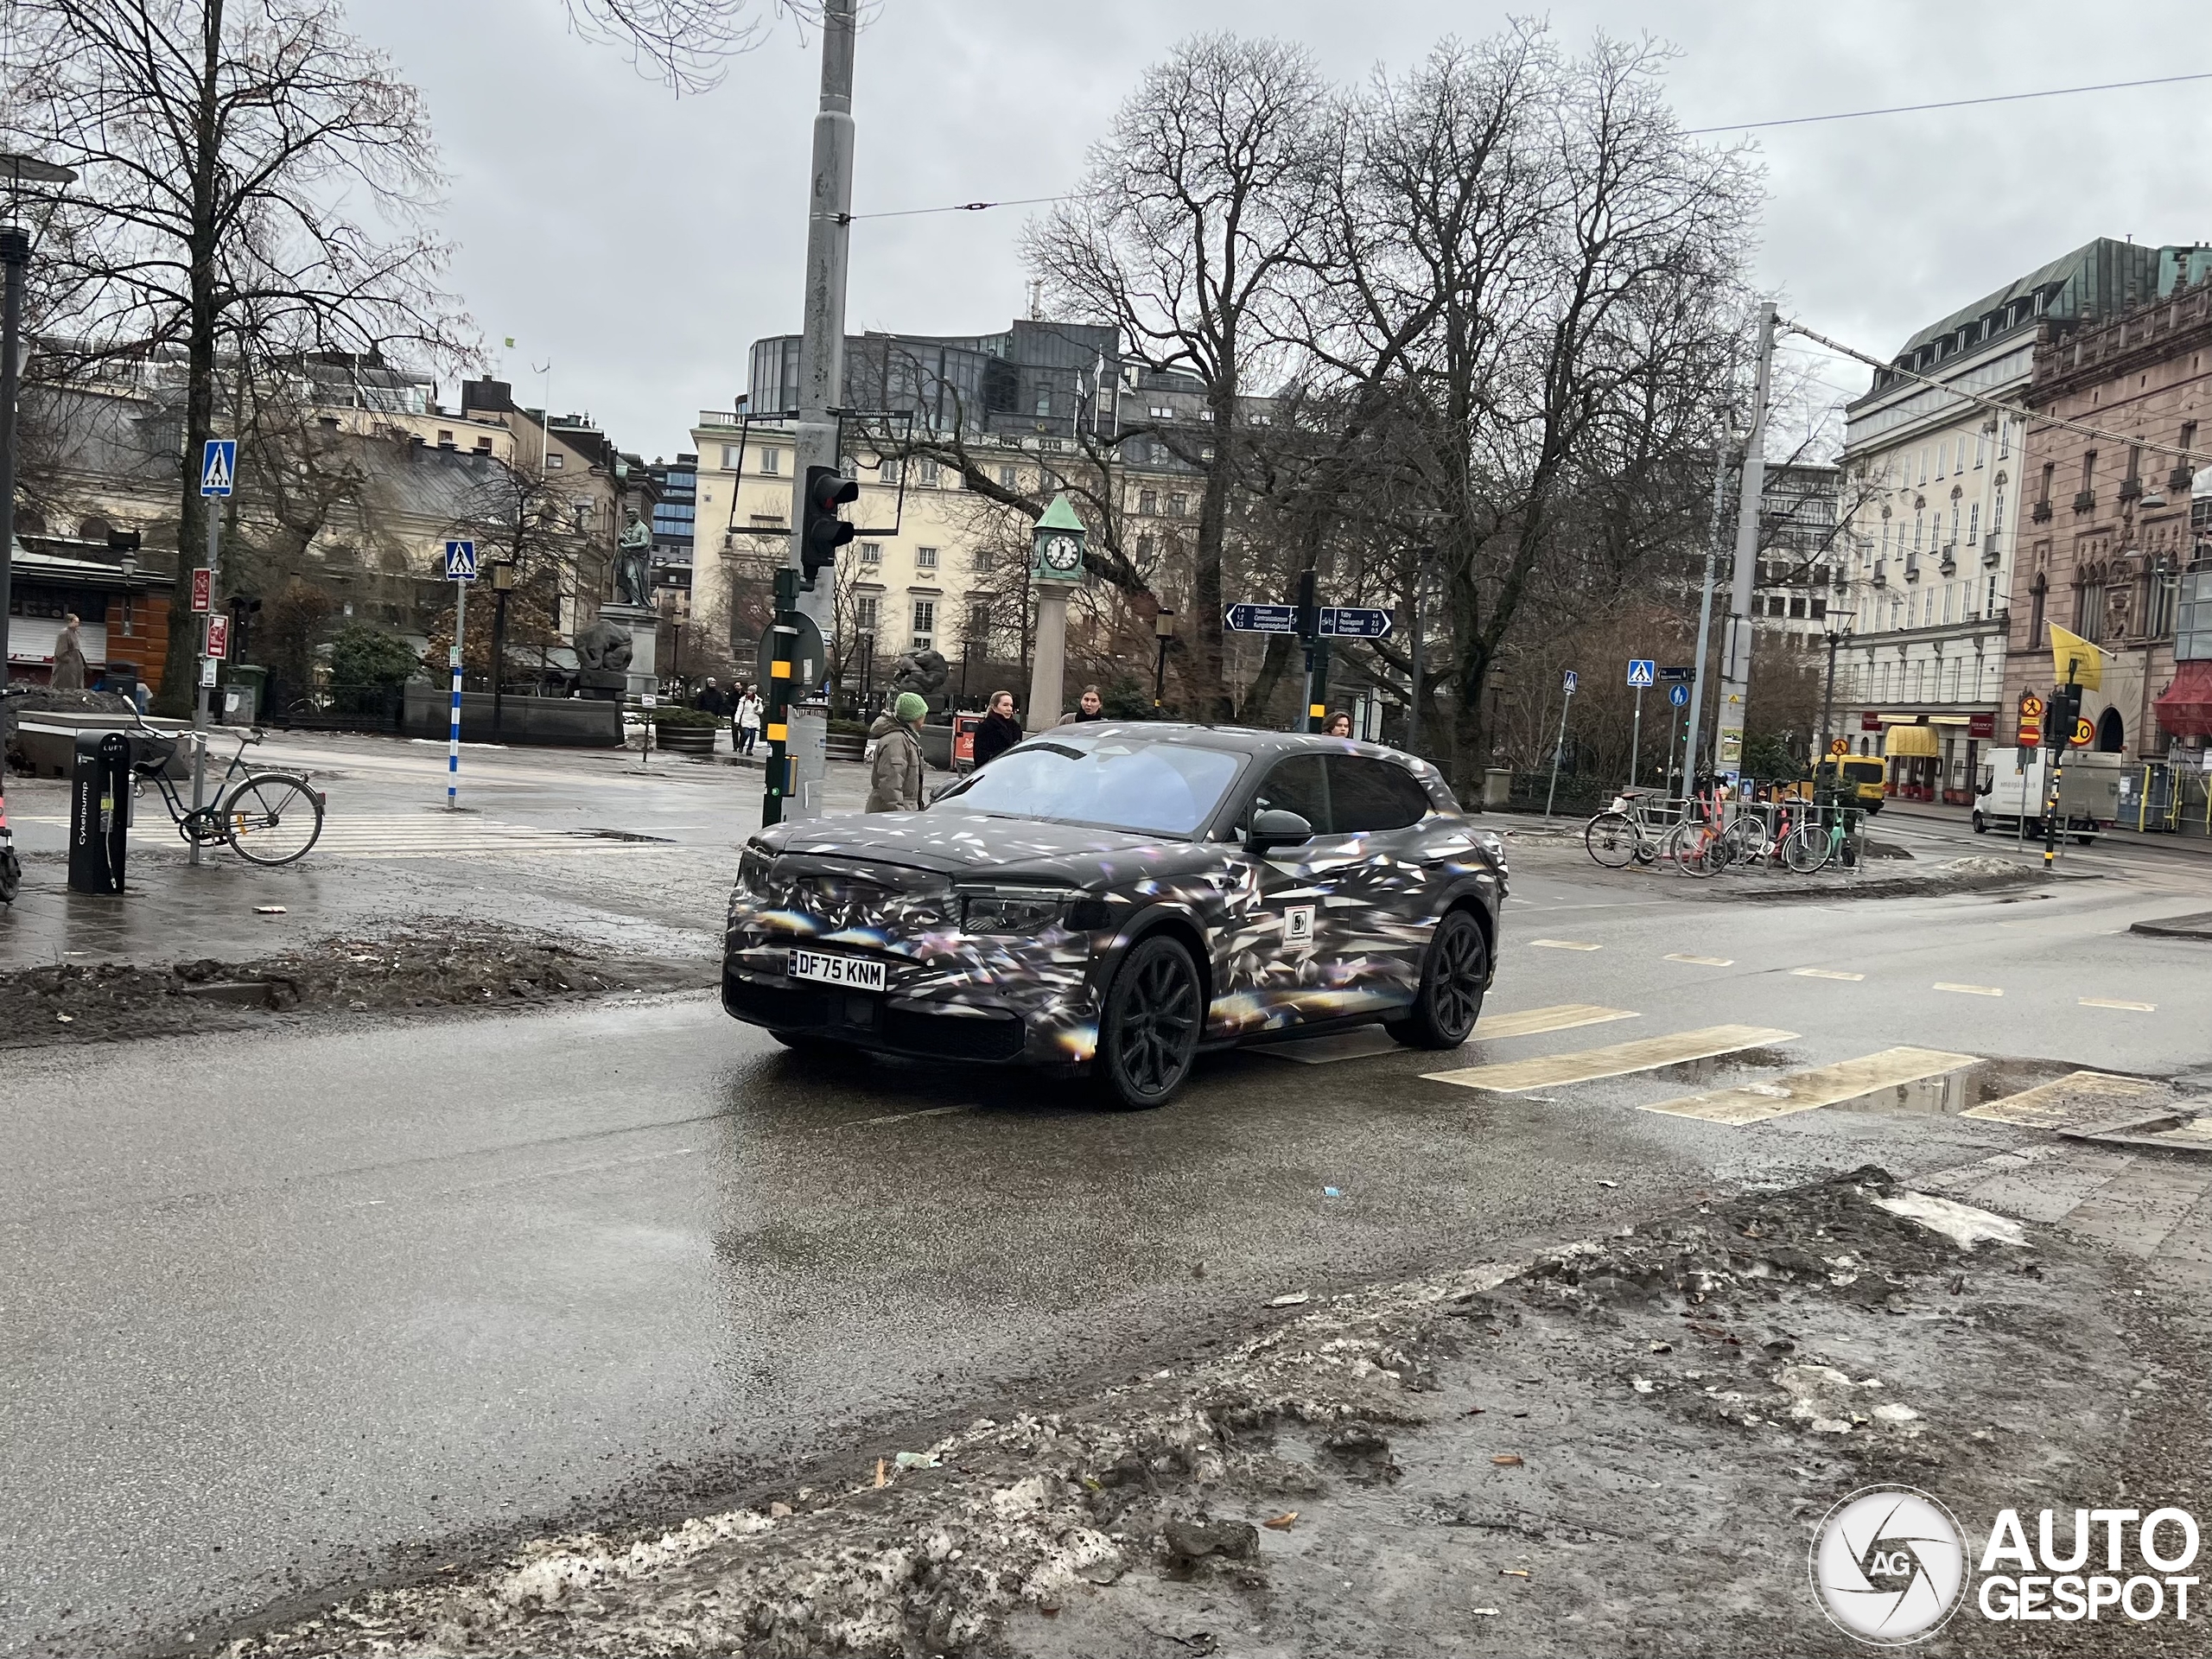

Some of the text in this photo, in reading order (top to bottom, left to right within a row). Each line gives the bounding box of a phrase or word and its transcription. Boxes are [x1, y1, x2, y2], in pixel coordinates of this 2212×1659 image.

[79, 781, 89, 846] Cykelpump
[799, 953, 881, 986] DF75 KNM
